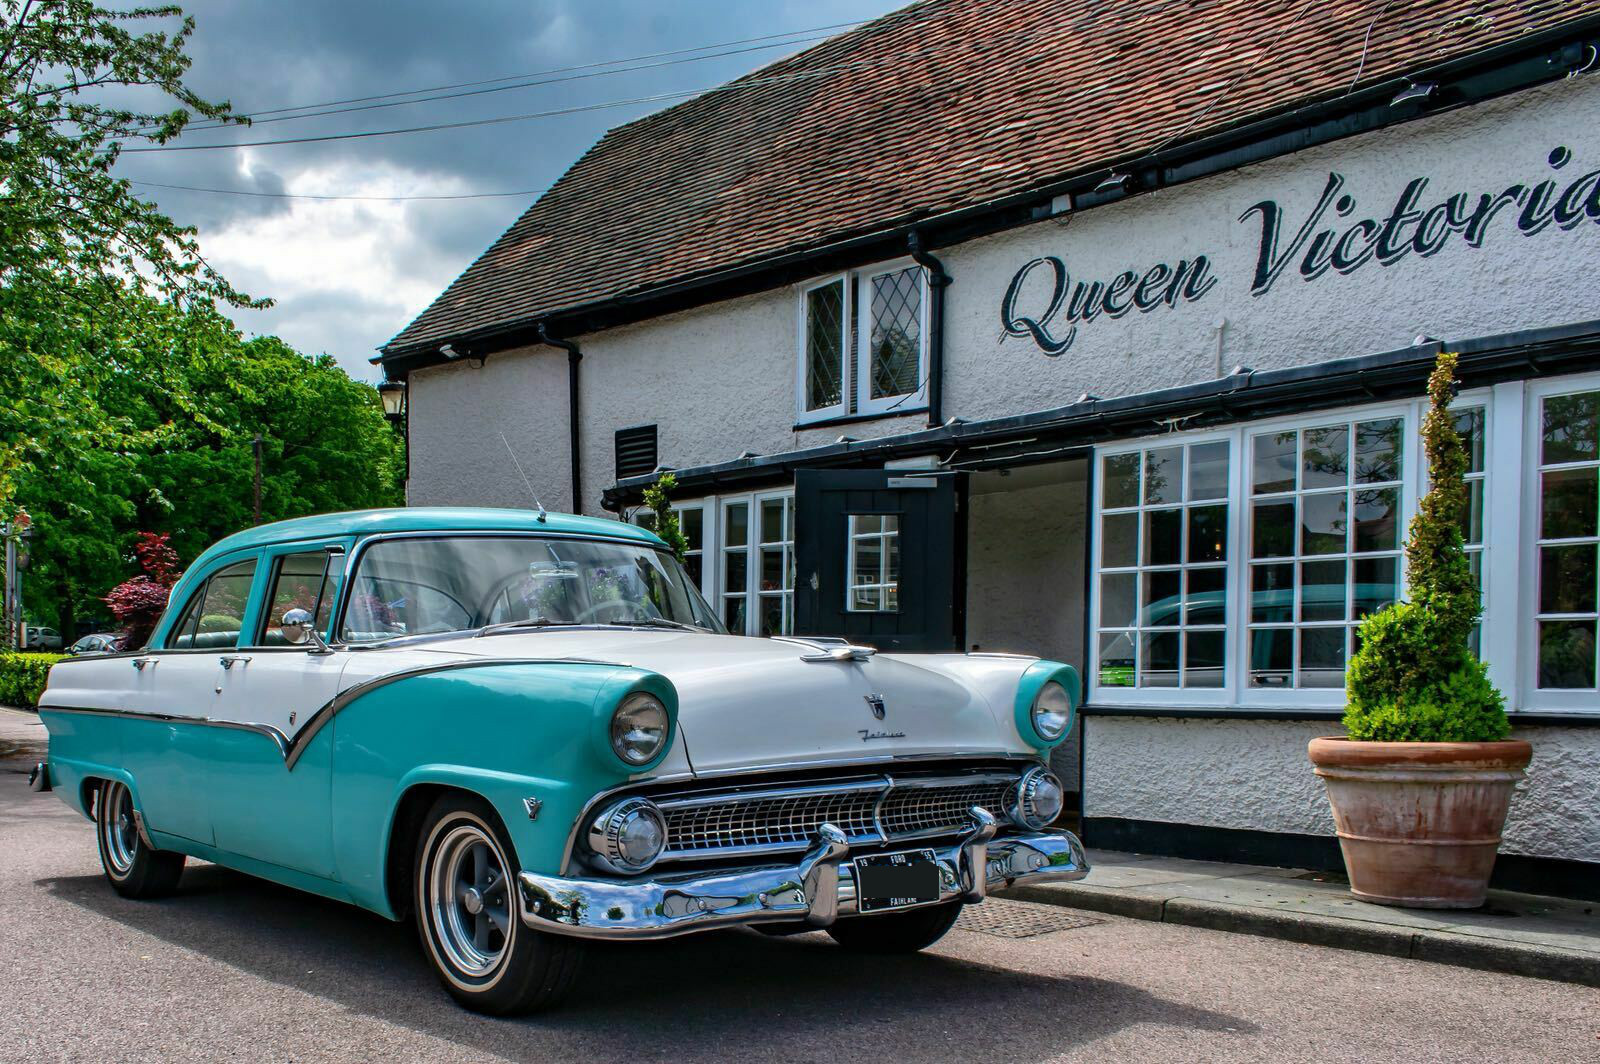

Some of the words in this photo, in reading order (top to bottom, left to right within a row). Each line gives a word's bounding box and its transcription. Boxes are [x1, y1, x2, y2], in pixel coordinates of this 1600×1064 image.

[997, 254, 1218, 358] Queen
[1237, 145, 1600, 297] Victoria
[890, 854, 906, 864] FORD
